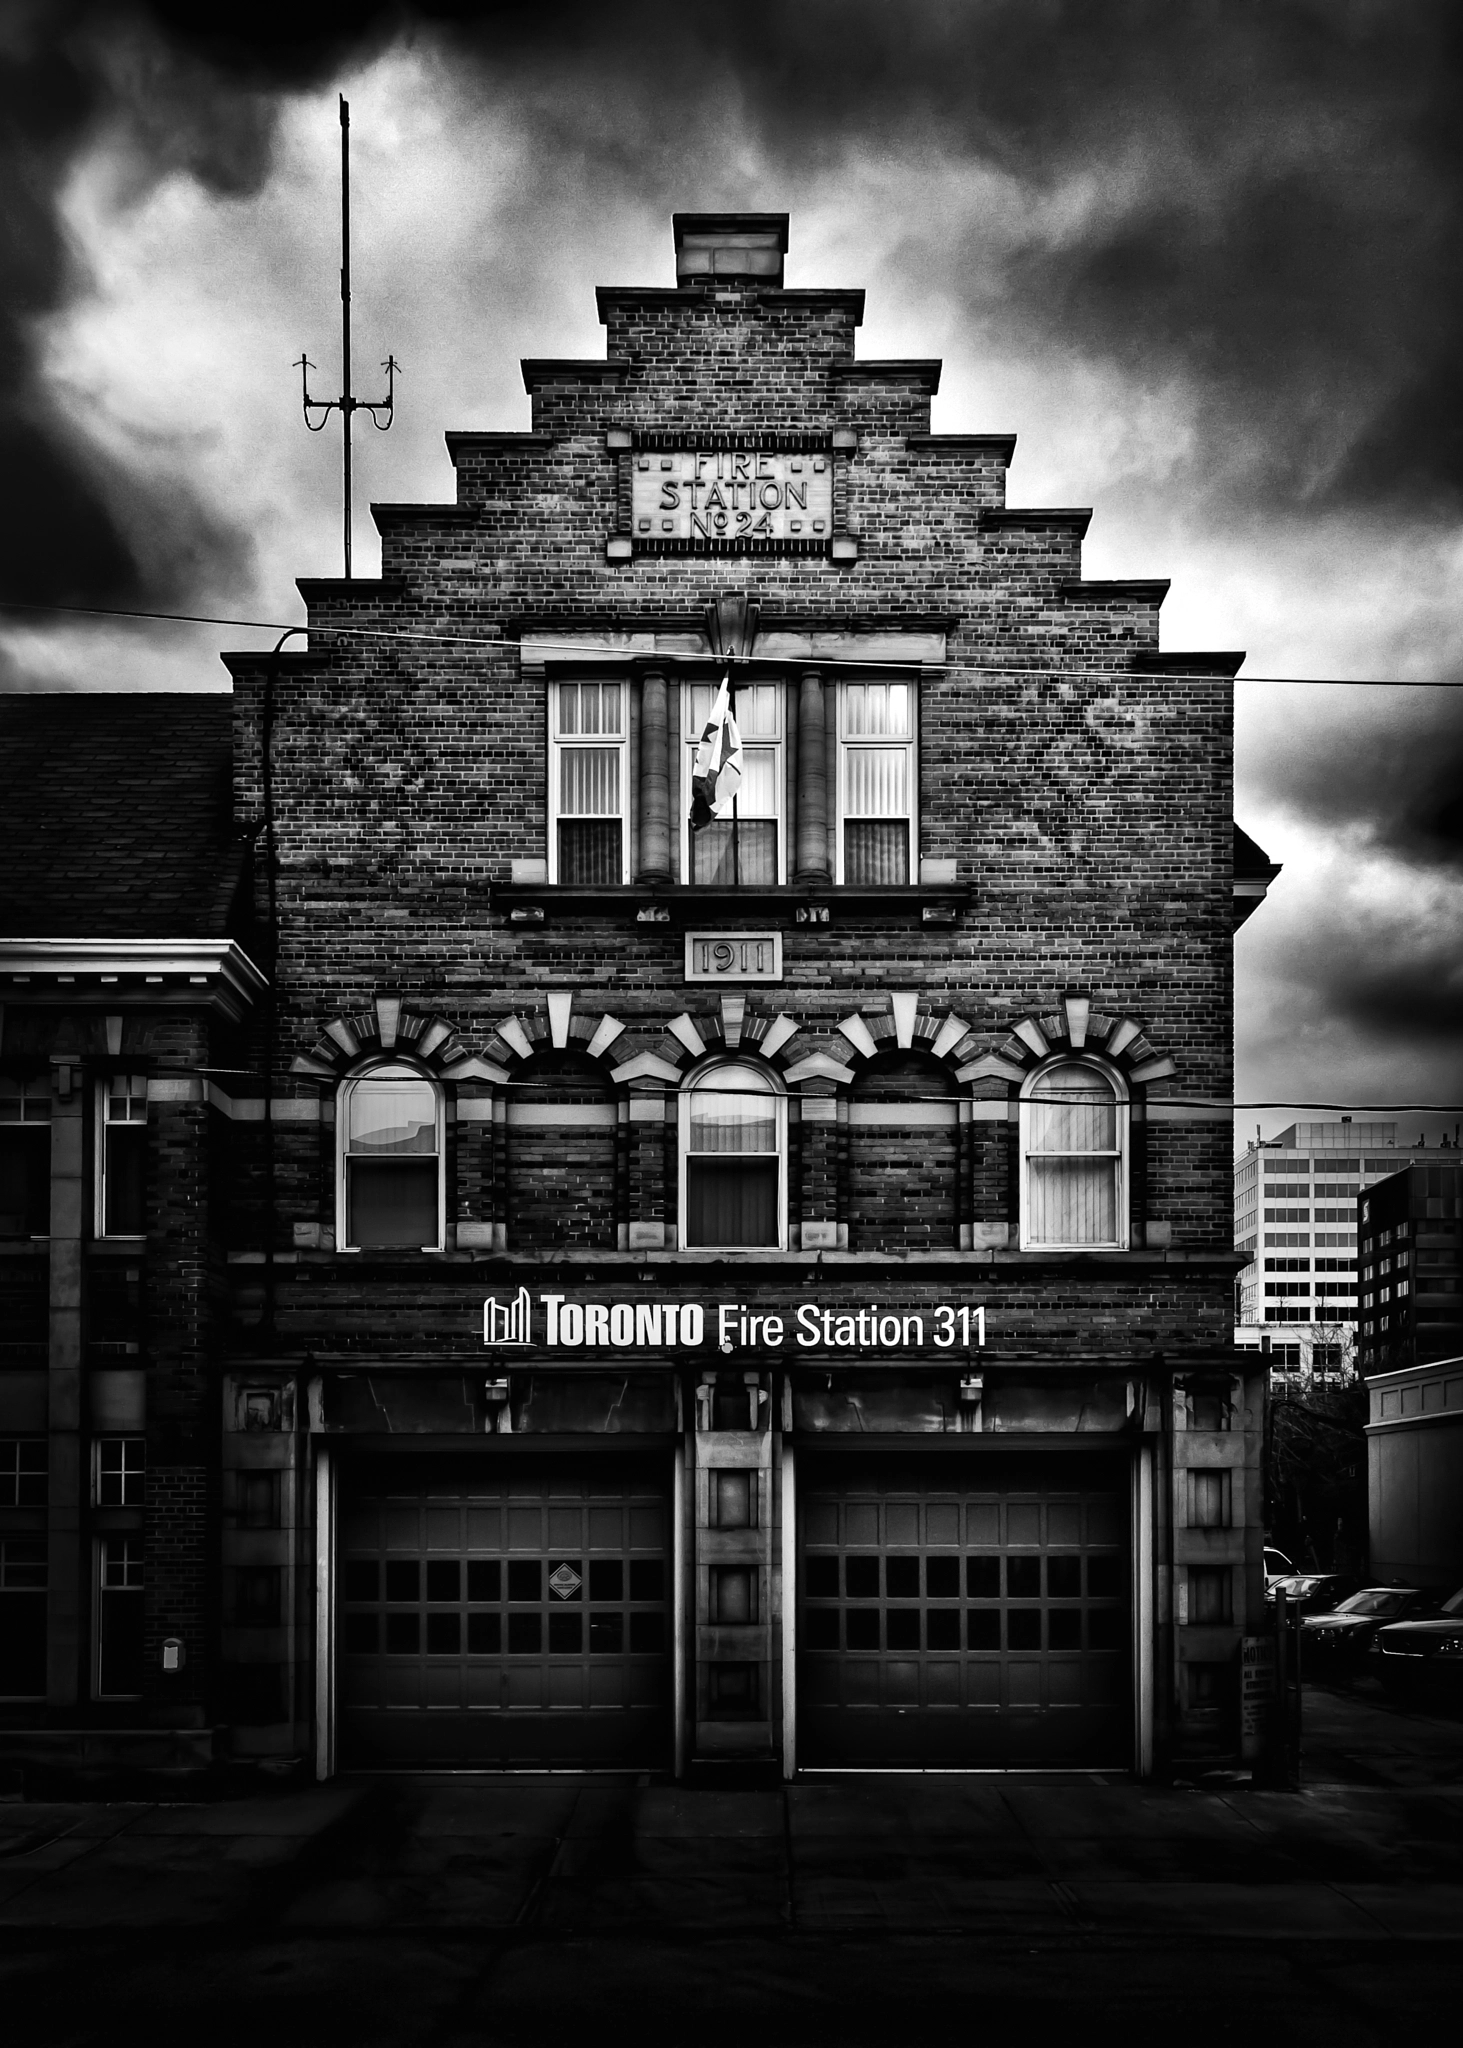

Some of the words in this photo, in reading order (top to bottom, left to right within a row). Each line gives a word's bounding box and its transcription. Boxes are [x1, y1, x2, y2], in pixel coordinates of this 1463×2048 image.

[695, 452, 775, 479] FIRE
[659, 481, 807, 510] STATION
[735, 512, 773, 538] 24
[702, 943, 764, 971] 1911
[540, 1294, 704, 1346] TORONTO
[719, 1304, 784, 1346] Fire
[796, 1304, 924, 1347] Station
[933, 1306, 986, 1347] 311
